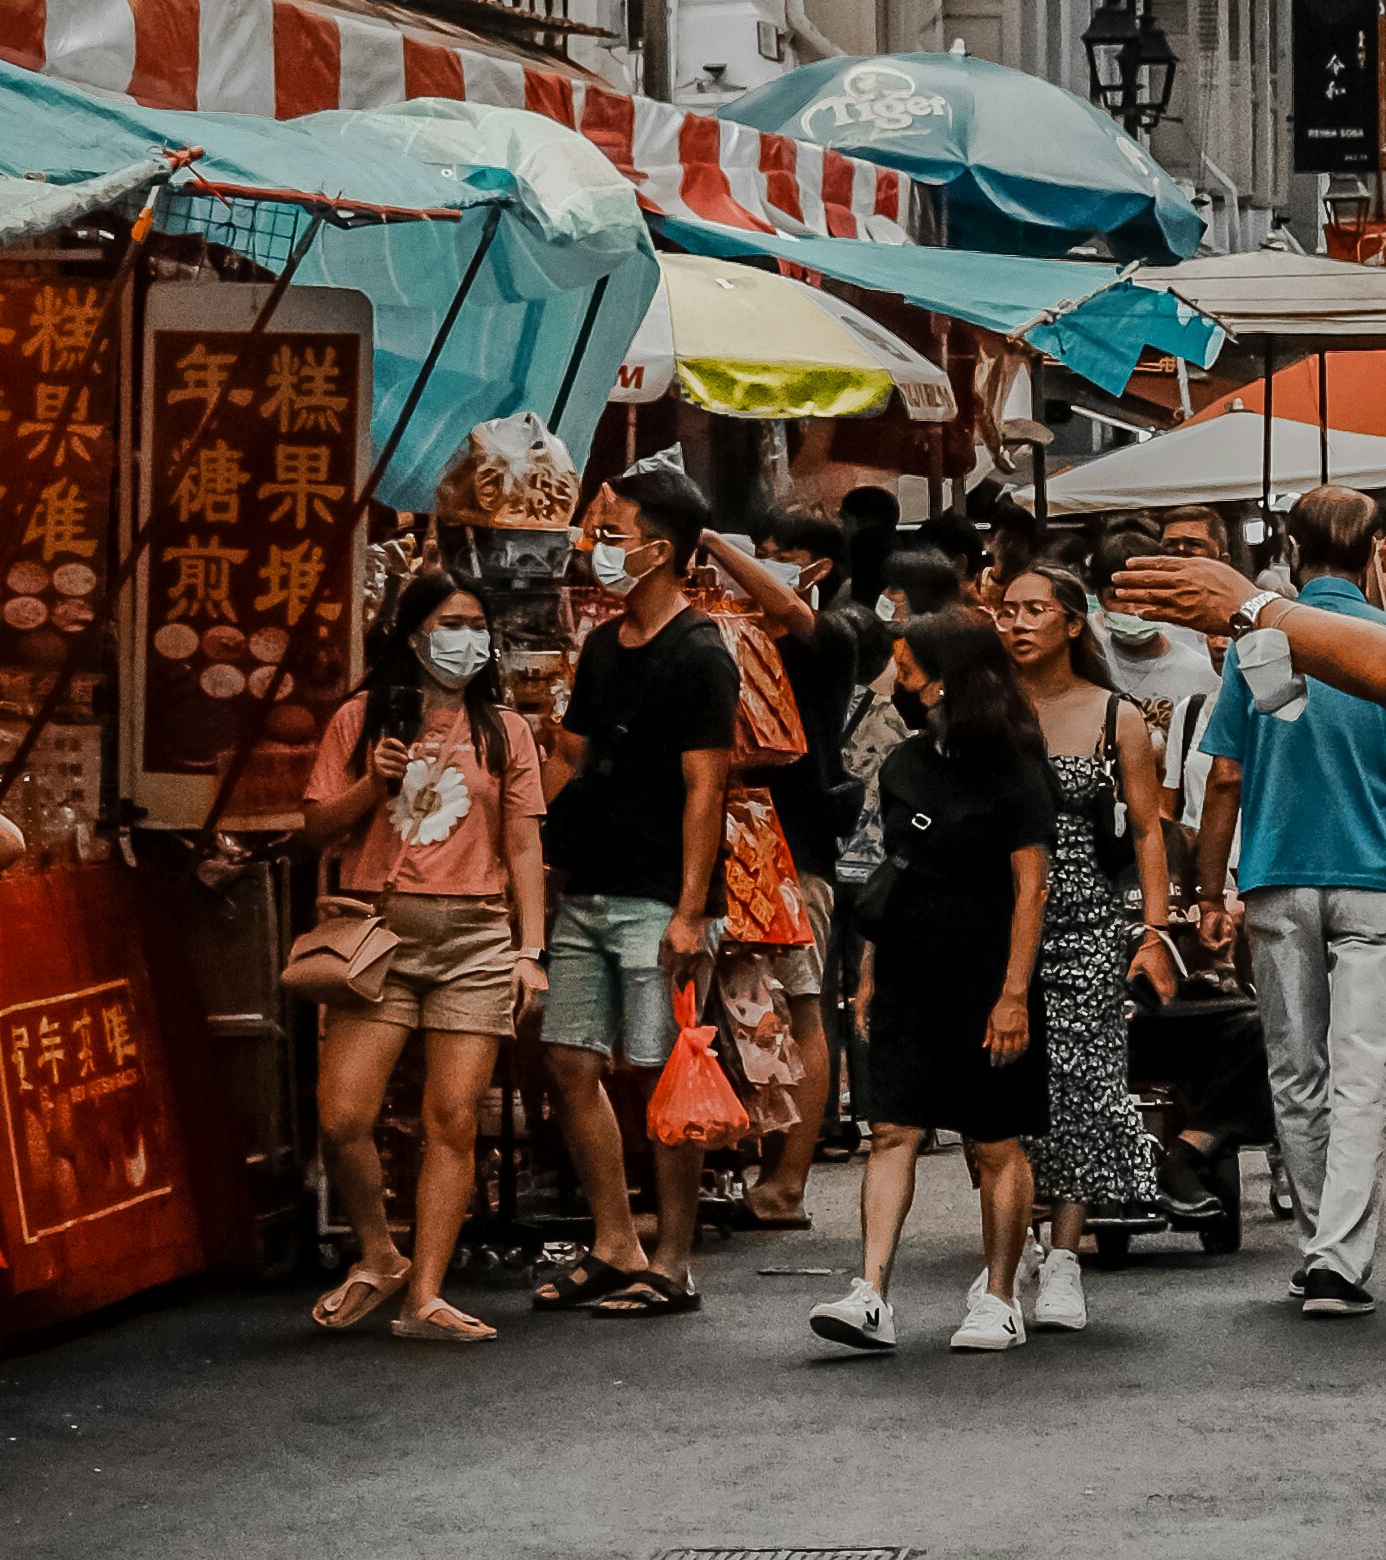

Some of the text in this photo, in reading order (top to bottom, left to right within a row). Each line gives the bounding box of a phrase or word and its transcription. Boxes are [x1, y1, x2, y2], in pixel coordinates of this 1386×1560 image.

[801, 91, 953, 137] Tiger
[166, 341, 350, 435] 年糕
[167, 443, 346, 530] 糖果
[163, 537, 343, 626] 煎堆
